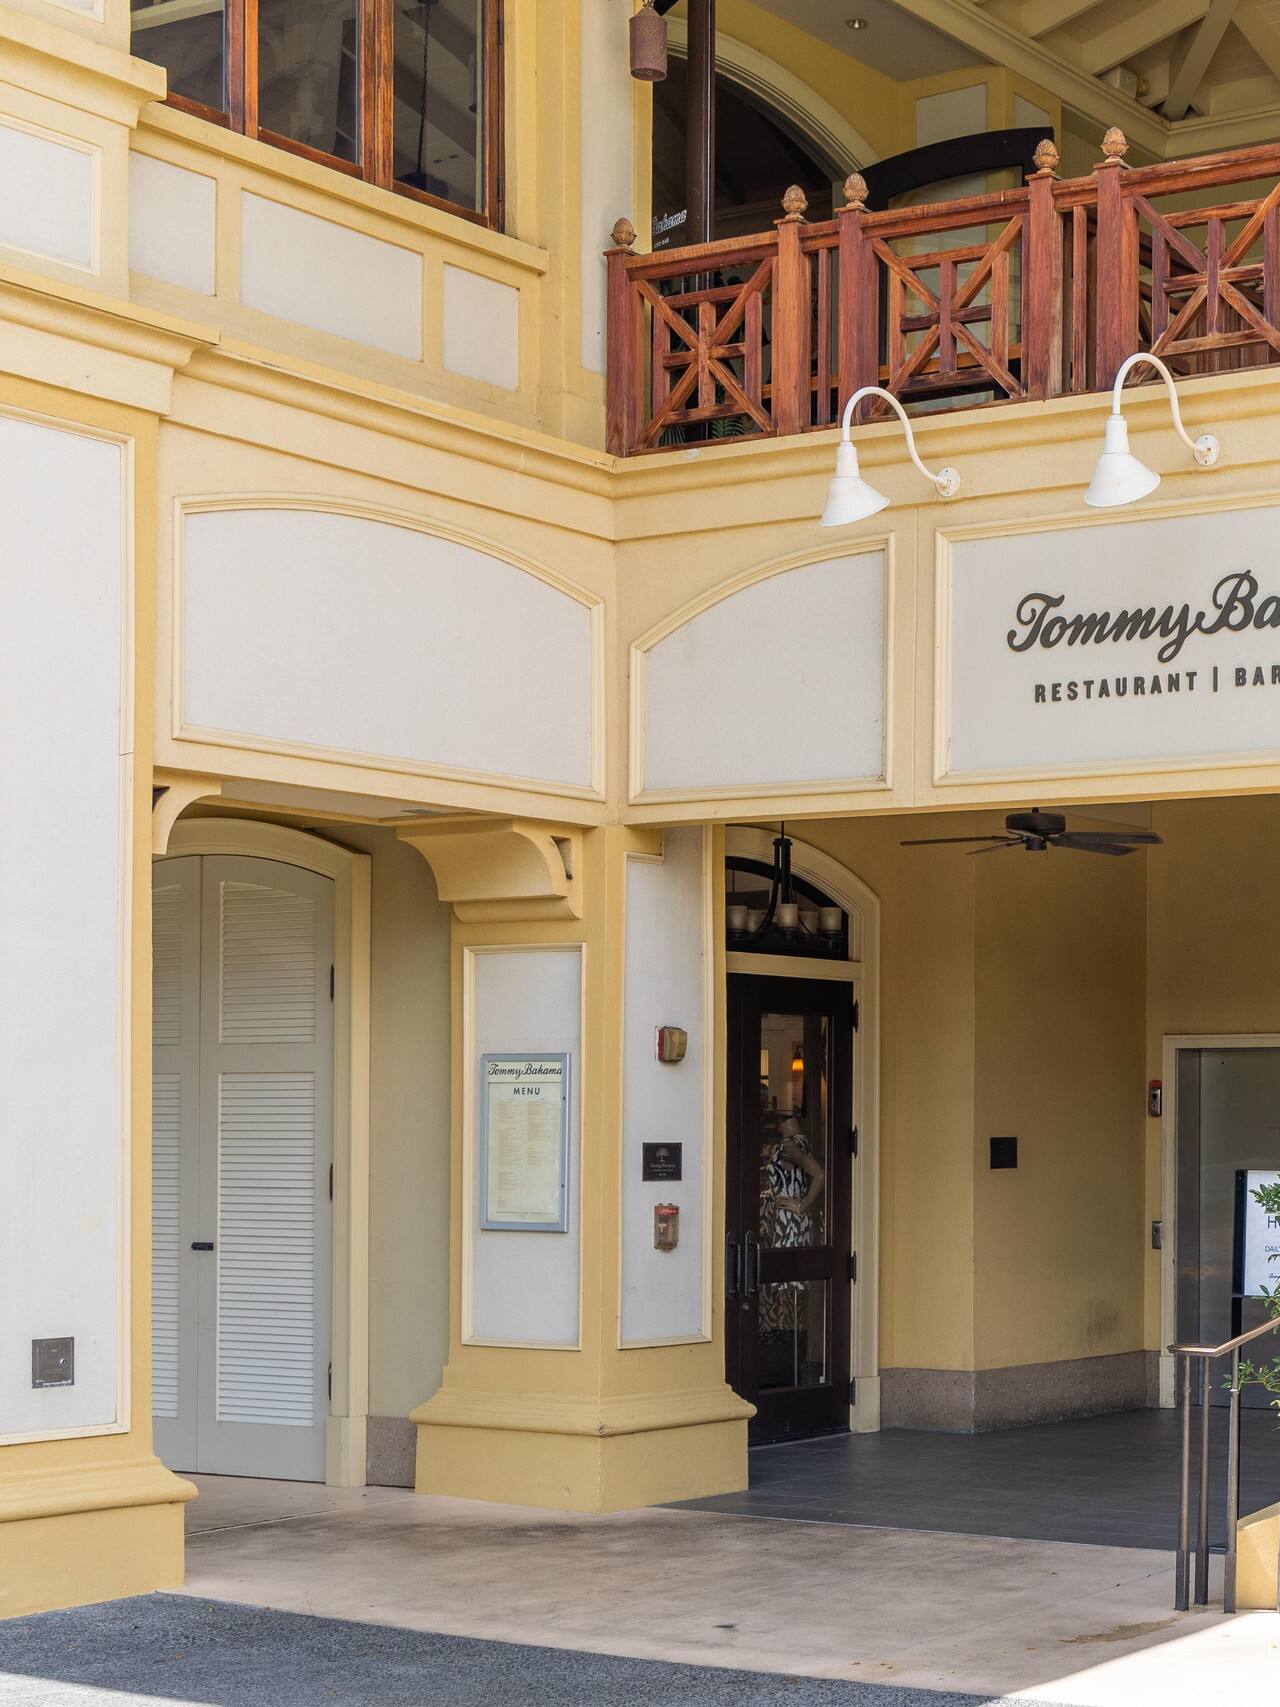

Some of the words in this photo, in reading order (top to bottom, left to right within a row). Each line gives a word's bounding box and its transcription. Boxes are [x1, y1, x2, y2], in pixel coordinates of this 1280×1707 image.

[1006, 592, 1203, 663] Tommy
[1034, 671, 1198, 703] RESTAURANT
[488, 1063, 521, 1080] Tommy
[521, 1063, 562, 1075] Bahama
[513, 1087, 541, 1095] MENU
